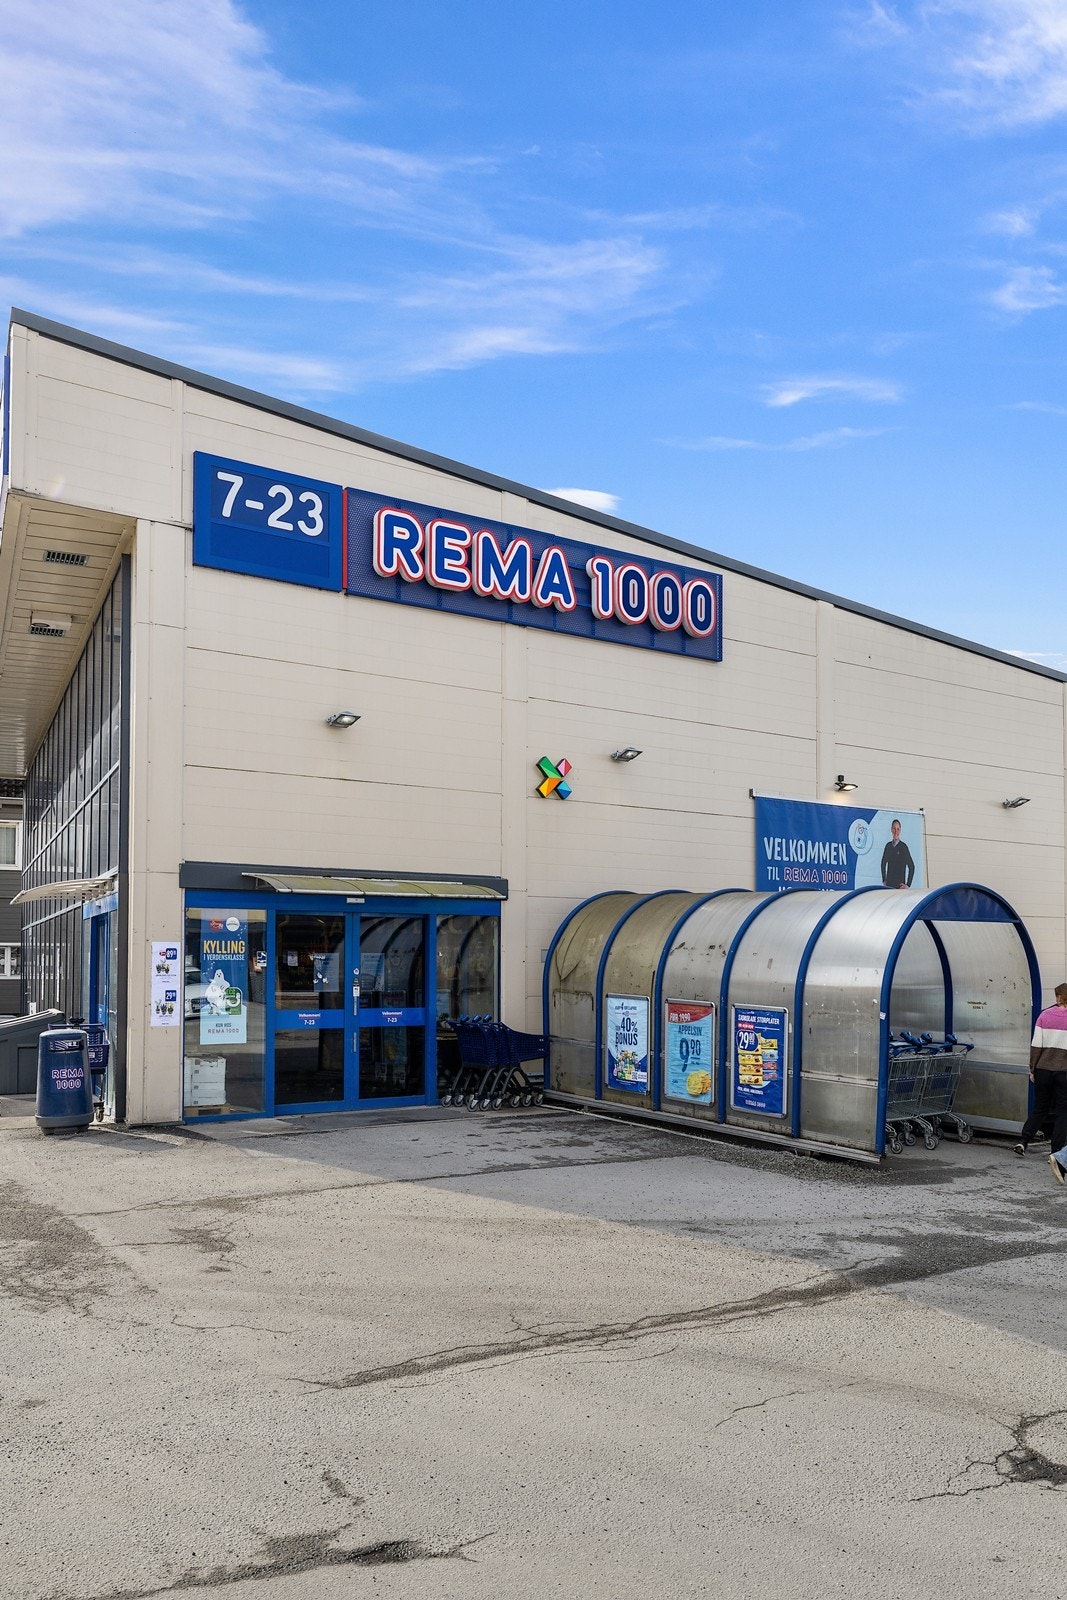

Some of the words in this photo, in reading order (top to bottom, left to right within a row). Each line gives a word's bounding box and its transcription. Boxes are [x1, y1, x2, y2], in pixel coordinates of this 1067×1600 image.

[216, 470, 324, 537] 7-23
[373, 506, 577, 612] REMA
[586, 554, 717, 638] 1000
[763, 836, 847, 866] VELKOMMEN
[767, 866, 780, 881] TIL
[783, 866, 819, 883] REMA
[822, 869, 848, 884] 1000
[203, 940, 246, 954] KYLLING
[620, 1017, 638, 1033] 40%
[738, 1014, 756, 1023] SJOKOLADE
[757, 1016, 780, 1025] STORPLATER
[678, 1025, 702, 1036] APPELSIN
[615, 1032, 638, 1046] BONUS
[739, 1031, 749, 1050] 29
[51, 1067, 84, 1079] REMA
[55, 1079, 82, 1090] 1000
